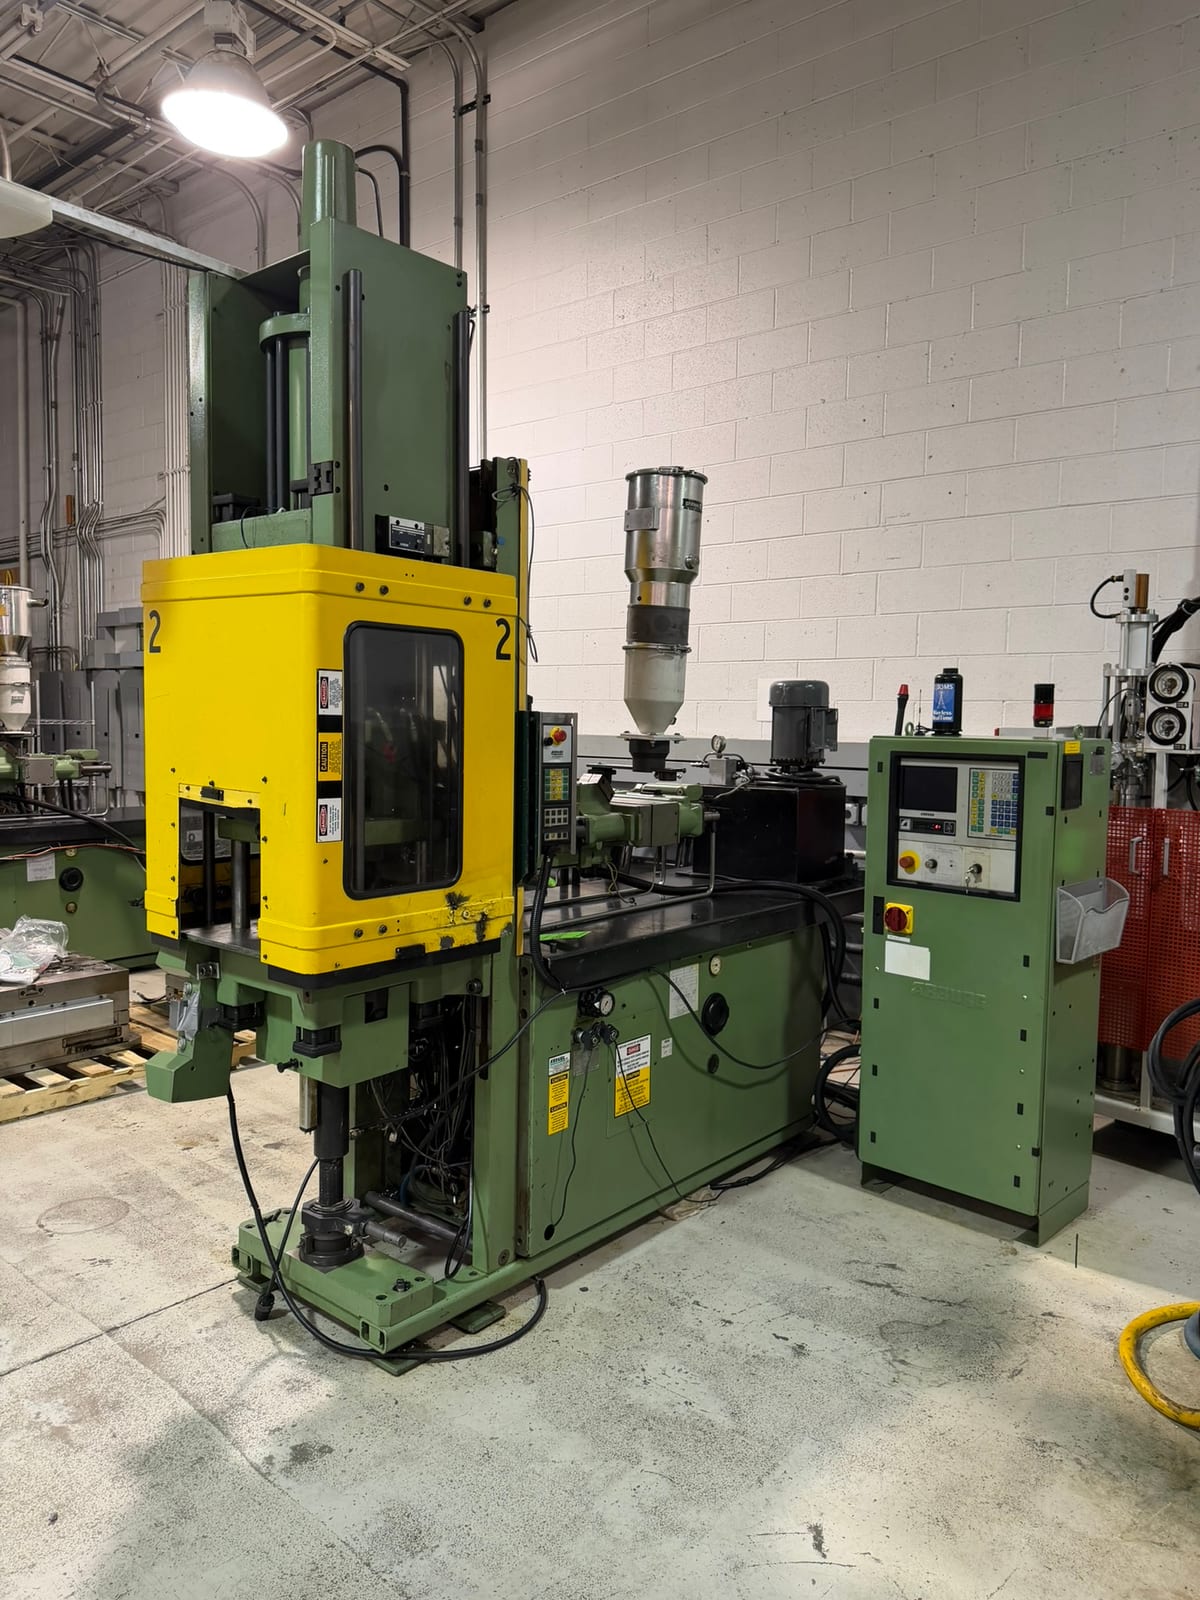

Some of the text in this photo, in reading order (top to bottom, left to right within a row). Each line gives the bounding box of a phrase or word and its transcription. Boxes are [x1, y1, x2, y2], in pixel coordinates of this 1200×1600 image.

[149, 609, 161, 654] 2
[495, 617, 511, 661] 2
[320, 743, 328, 771] CAUTION
